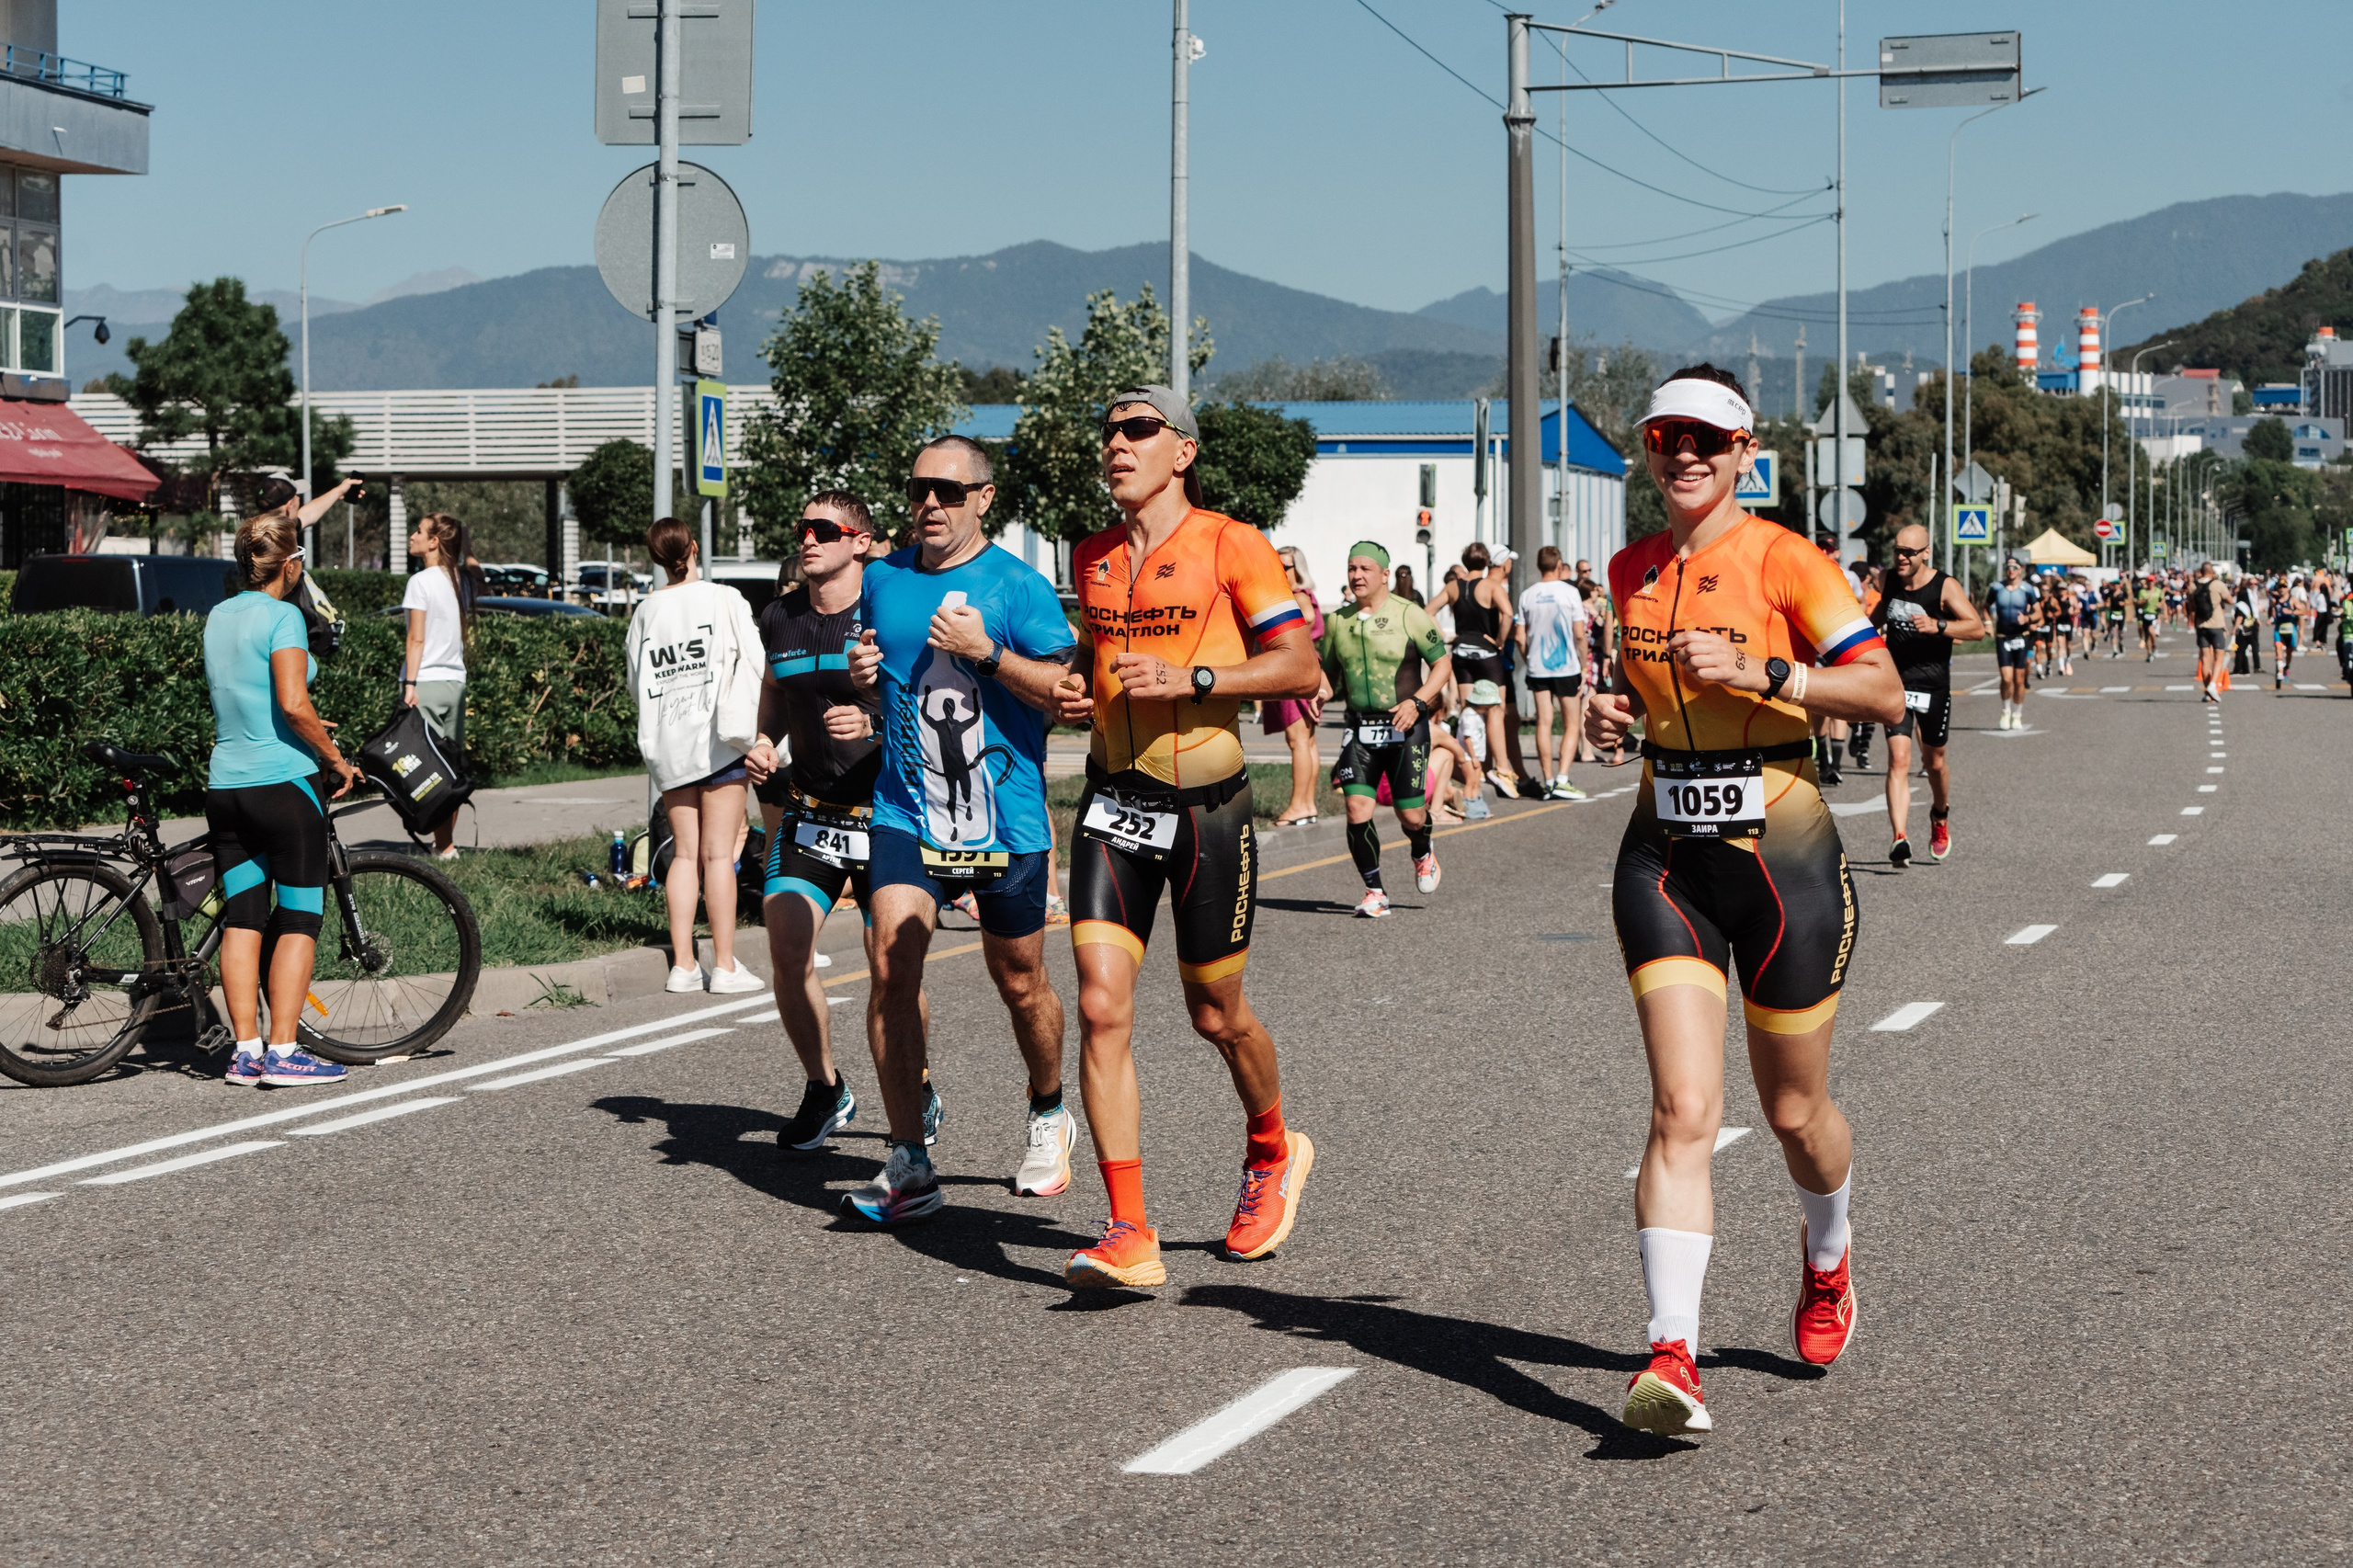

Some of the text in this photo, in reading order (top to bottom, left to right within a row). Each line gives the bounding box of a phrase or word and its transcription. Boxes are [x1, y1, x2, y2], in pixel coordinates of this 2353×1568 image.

[1734, 403, 1746, 415] cep
[1085, 606, 1197, 623] РОСНЕФТЬ
[1089, 624, 1179, 637] ТРИАТЛОН
[1622, 626, 1746, 644] РОСНТЬ
[654, 662, 706, 679] KEEP WARM
[1667, 784, 1743, 816] 1059
[1108, 807, 1155, 841] 252
[1691, 824, 1718, 834] ЗАИРА
[815, 829, 849, 855] 841
[1111, 836, 1140, 851] АНДРЕЙ
[951, 867, 974, 875] СЕРГЕЙ
[1231, 824, 1250, 943] РОСНЕФТЬ
[1830, 852, 1855, 985] РОСНЕФТЬ
[277, 1061, 317, 1072] SCOTT
